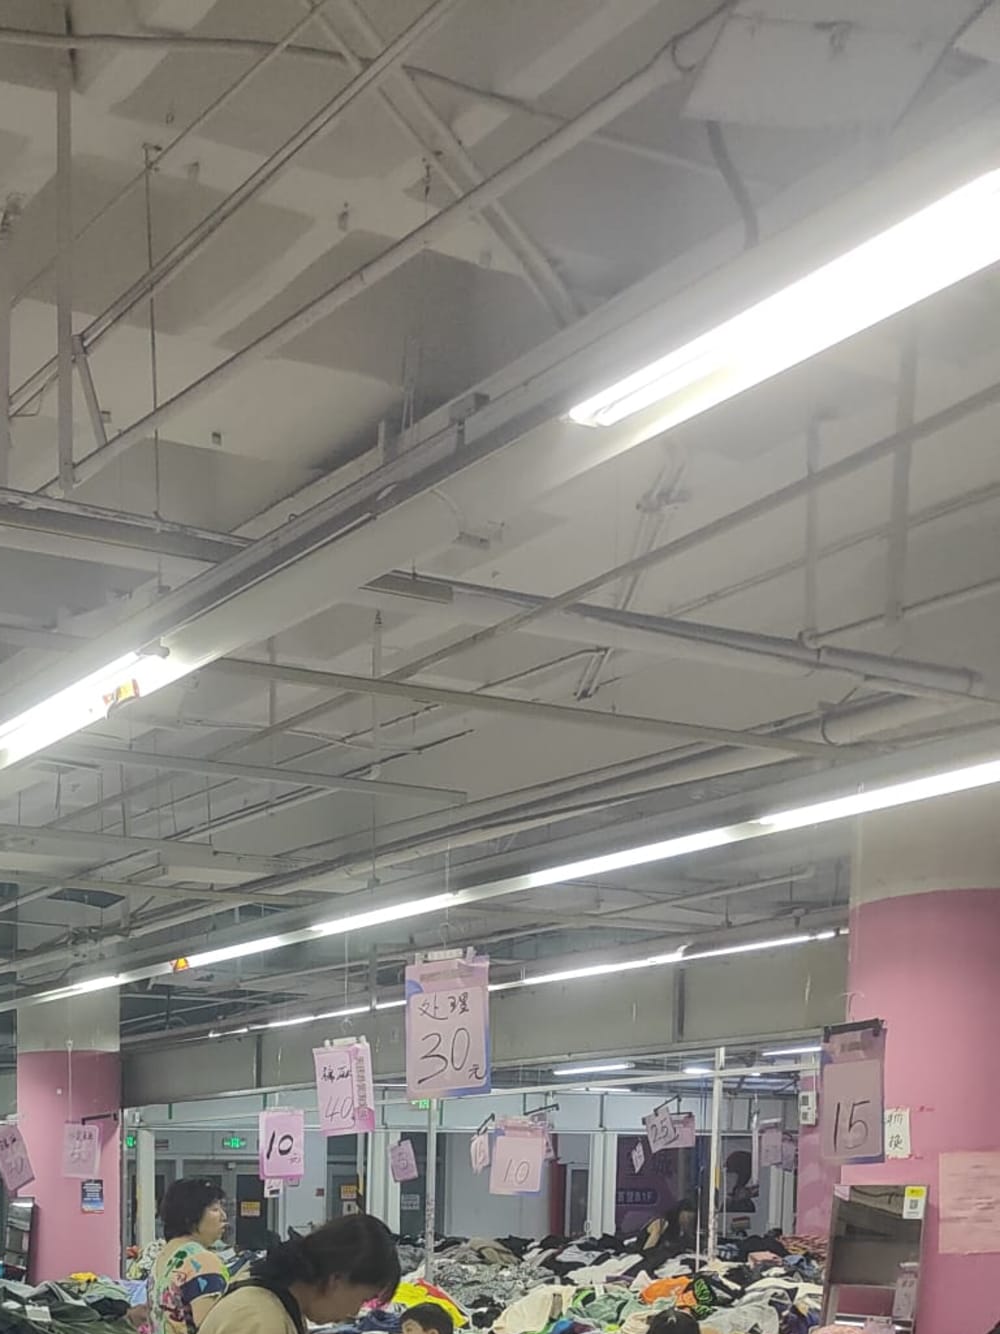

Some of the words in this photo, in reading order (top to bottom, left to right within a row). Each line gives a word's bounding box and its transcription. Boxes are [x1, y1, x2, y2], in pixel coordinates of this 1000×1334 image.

[418, 991, 470, 1021] 处理
[834, 1100, 871, 1153] 15
[503, 1158, 531, 1185] 10
